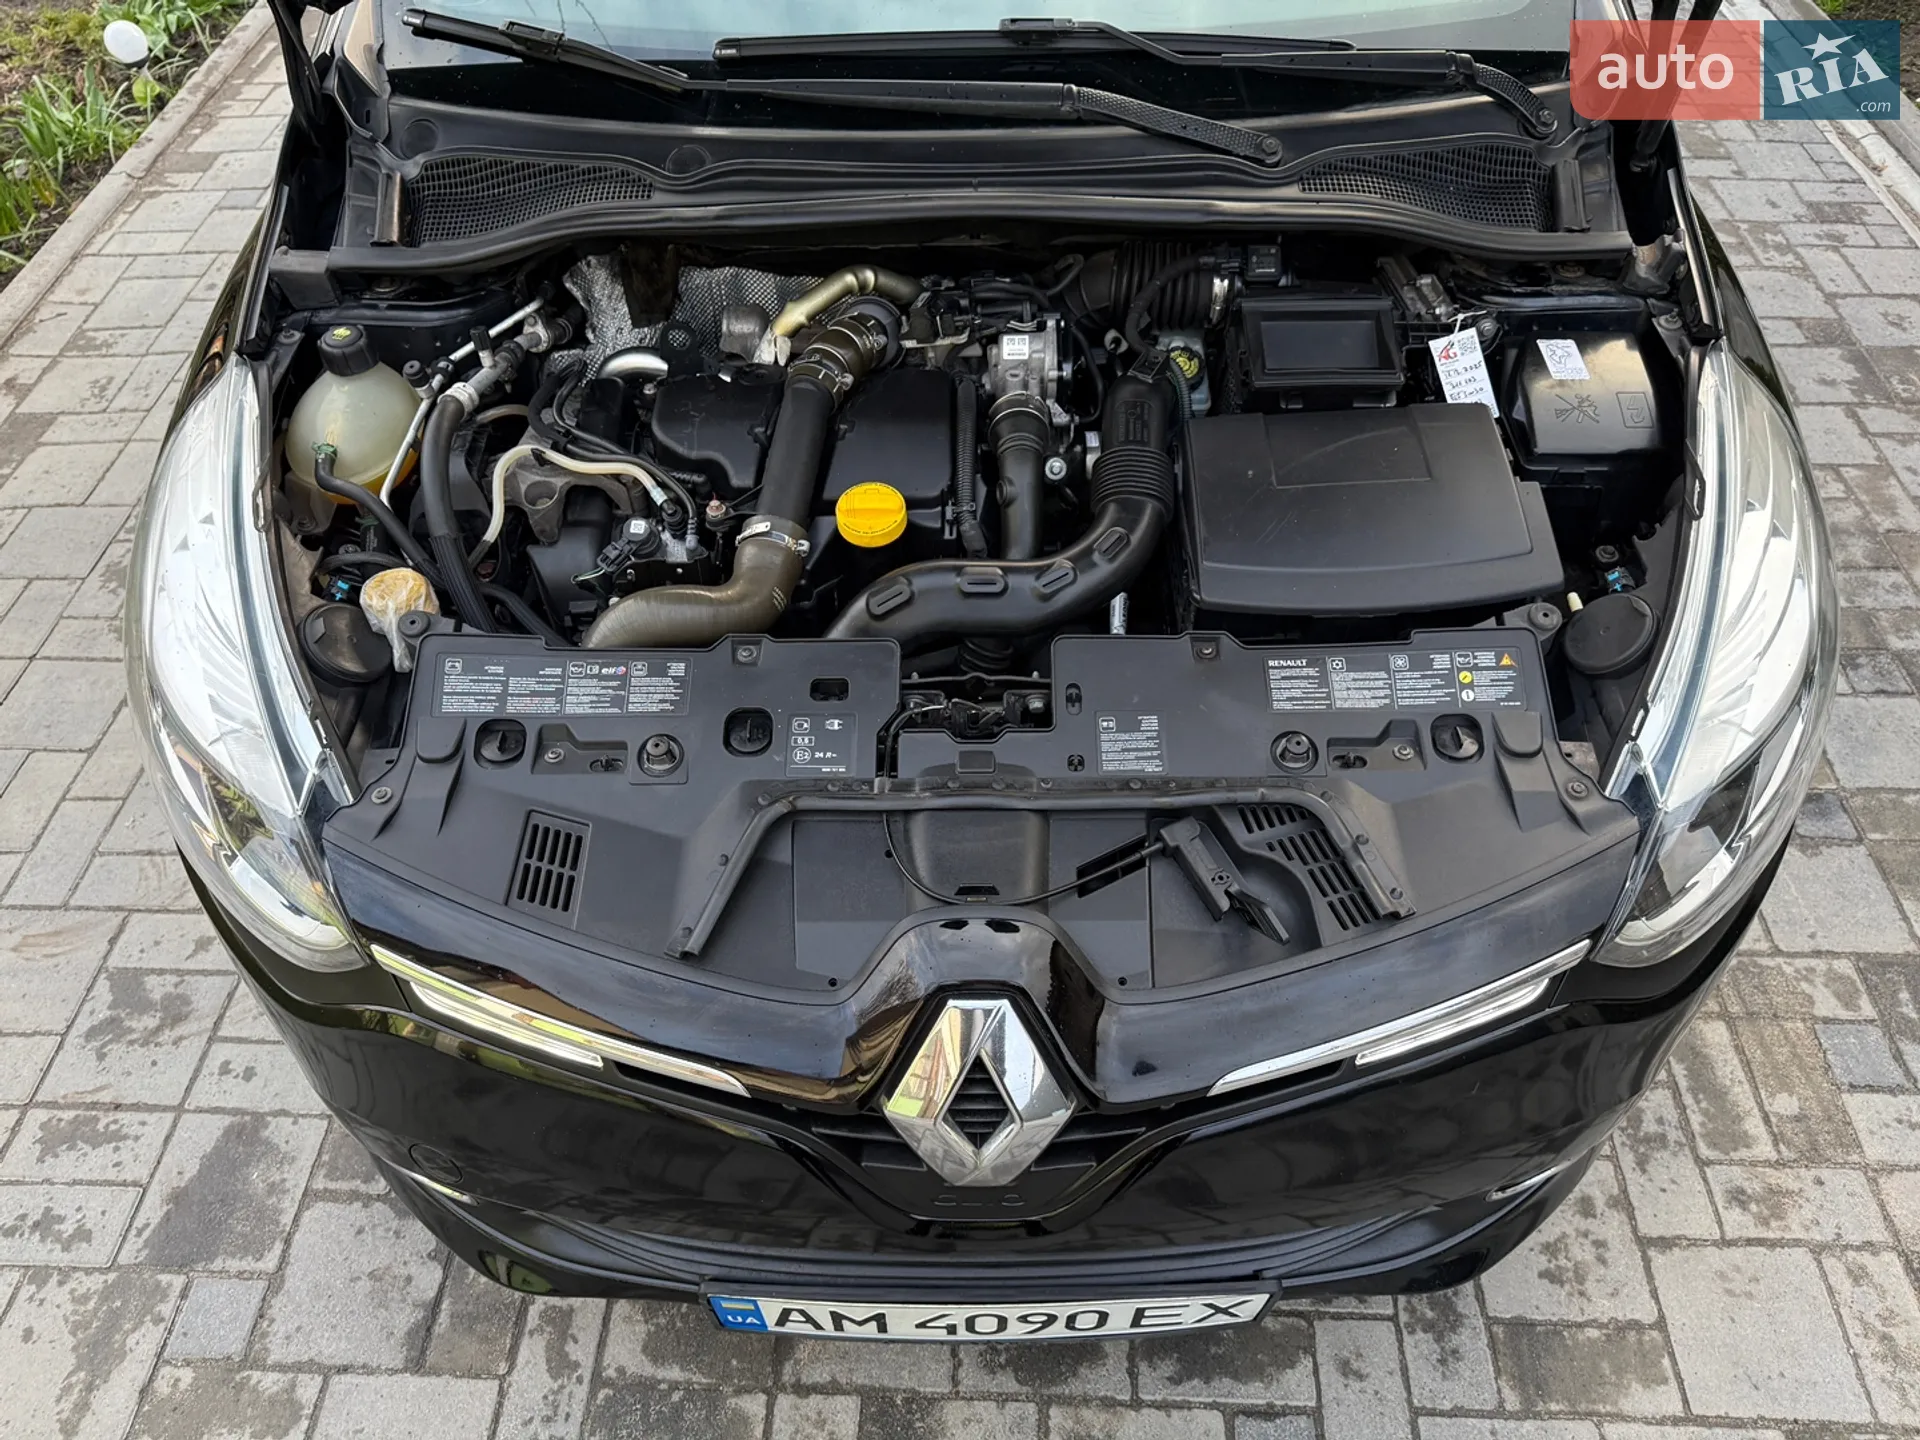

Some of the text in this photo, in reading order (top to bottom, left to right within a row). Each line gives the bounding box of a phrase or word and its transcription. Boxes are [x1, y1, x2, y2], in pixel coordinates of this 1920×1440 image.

[601, 665, 617, 674] elf
[727, 1314, 761, 1324] UA
[774, 1298, 1255, 1335] AM 4090 EX
